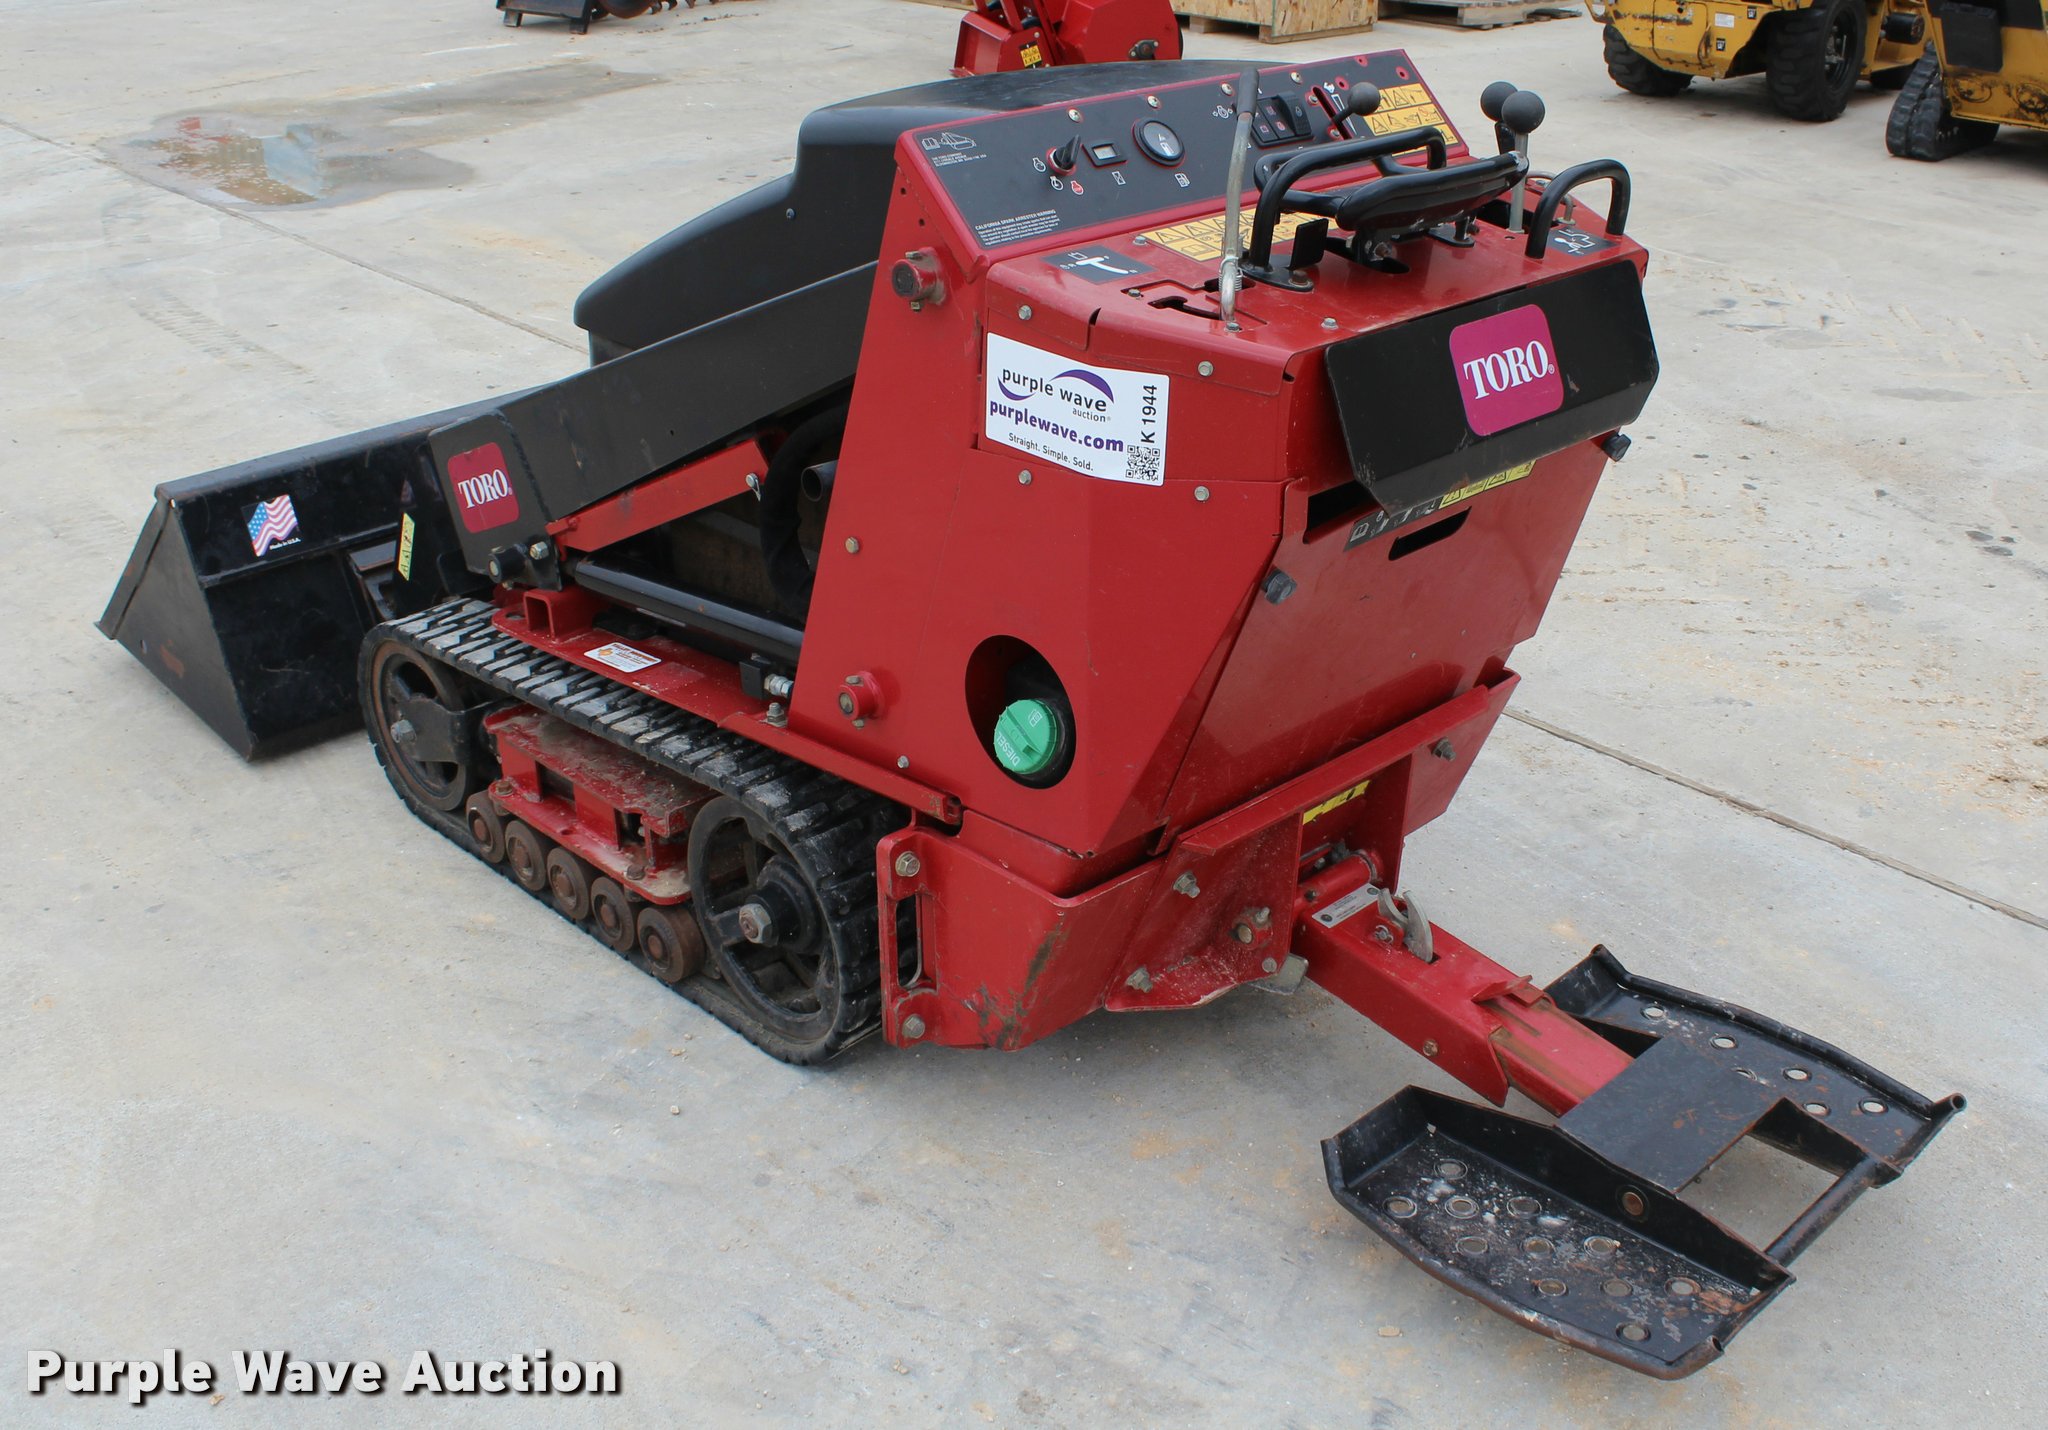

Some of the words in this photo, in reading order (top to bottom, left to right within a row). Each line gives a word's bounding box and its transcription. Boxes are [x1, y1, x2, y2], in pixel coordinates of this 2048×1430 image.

[1463, 340, 1549, 400] TORO
[1002, 368, 1053, 396] purple
[1059, 387, 1107, 412] wave
[1142, 384, 1158, 425] 1944
[990, 400, 1124, 452] purplewave.com
[1072, 407, 1106, 423] auction
[1008, 432, 1040, 451] Straight.
[1042, 446, 1070, 464] Simple.
[1073, 456, 1094, 471] Sold.
[1141, 430, 1156, 444] K
[458, 469, 508, 508] TORO
[996, 731, 1021, 766] DIESEL
